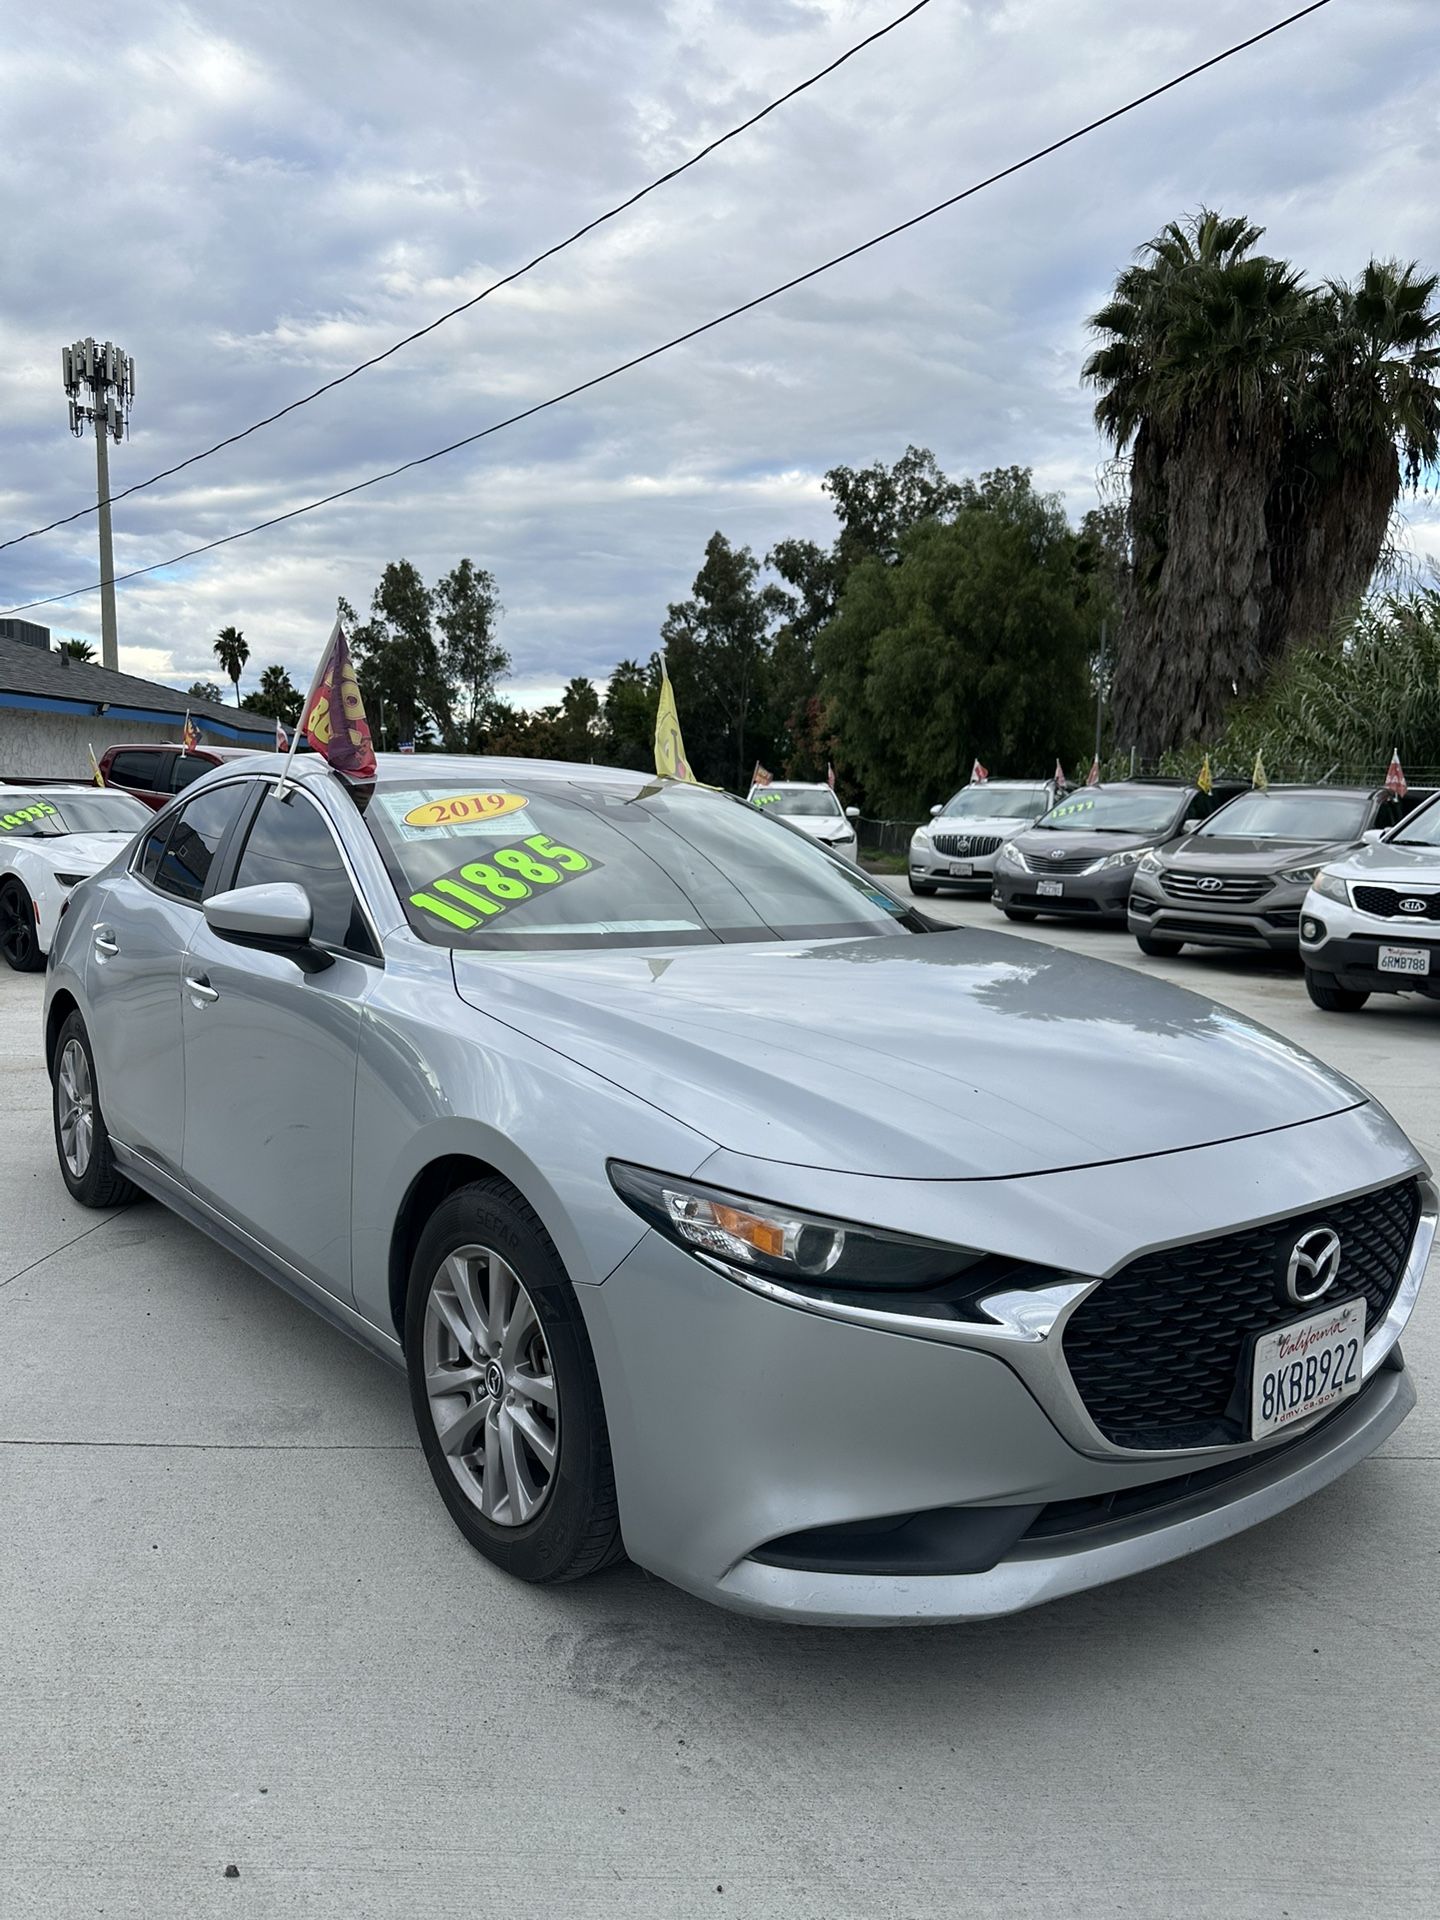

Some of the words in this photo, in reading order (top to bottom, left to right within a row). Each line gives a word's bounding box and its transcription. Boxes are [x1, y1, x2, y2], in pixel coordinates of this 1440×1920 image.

[429, 794, 506, 823] 2019
[409, 833, 592, 931] 11885
[1381, 955, 1426, 971] 6RMB788
[1279, 1322, 1348, 1359] California
[1261, 1338, 1358, 1421] 8KBB922
[1279, 1391, 1337, 1423] dmv.ca.gov
